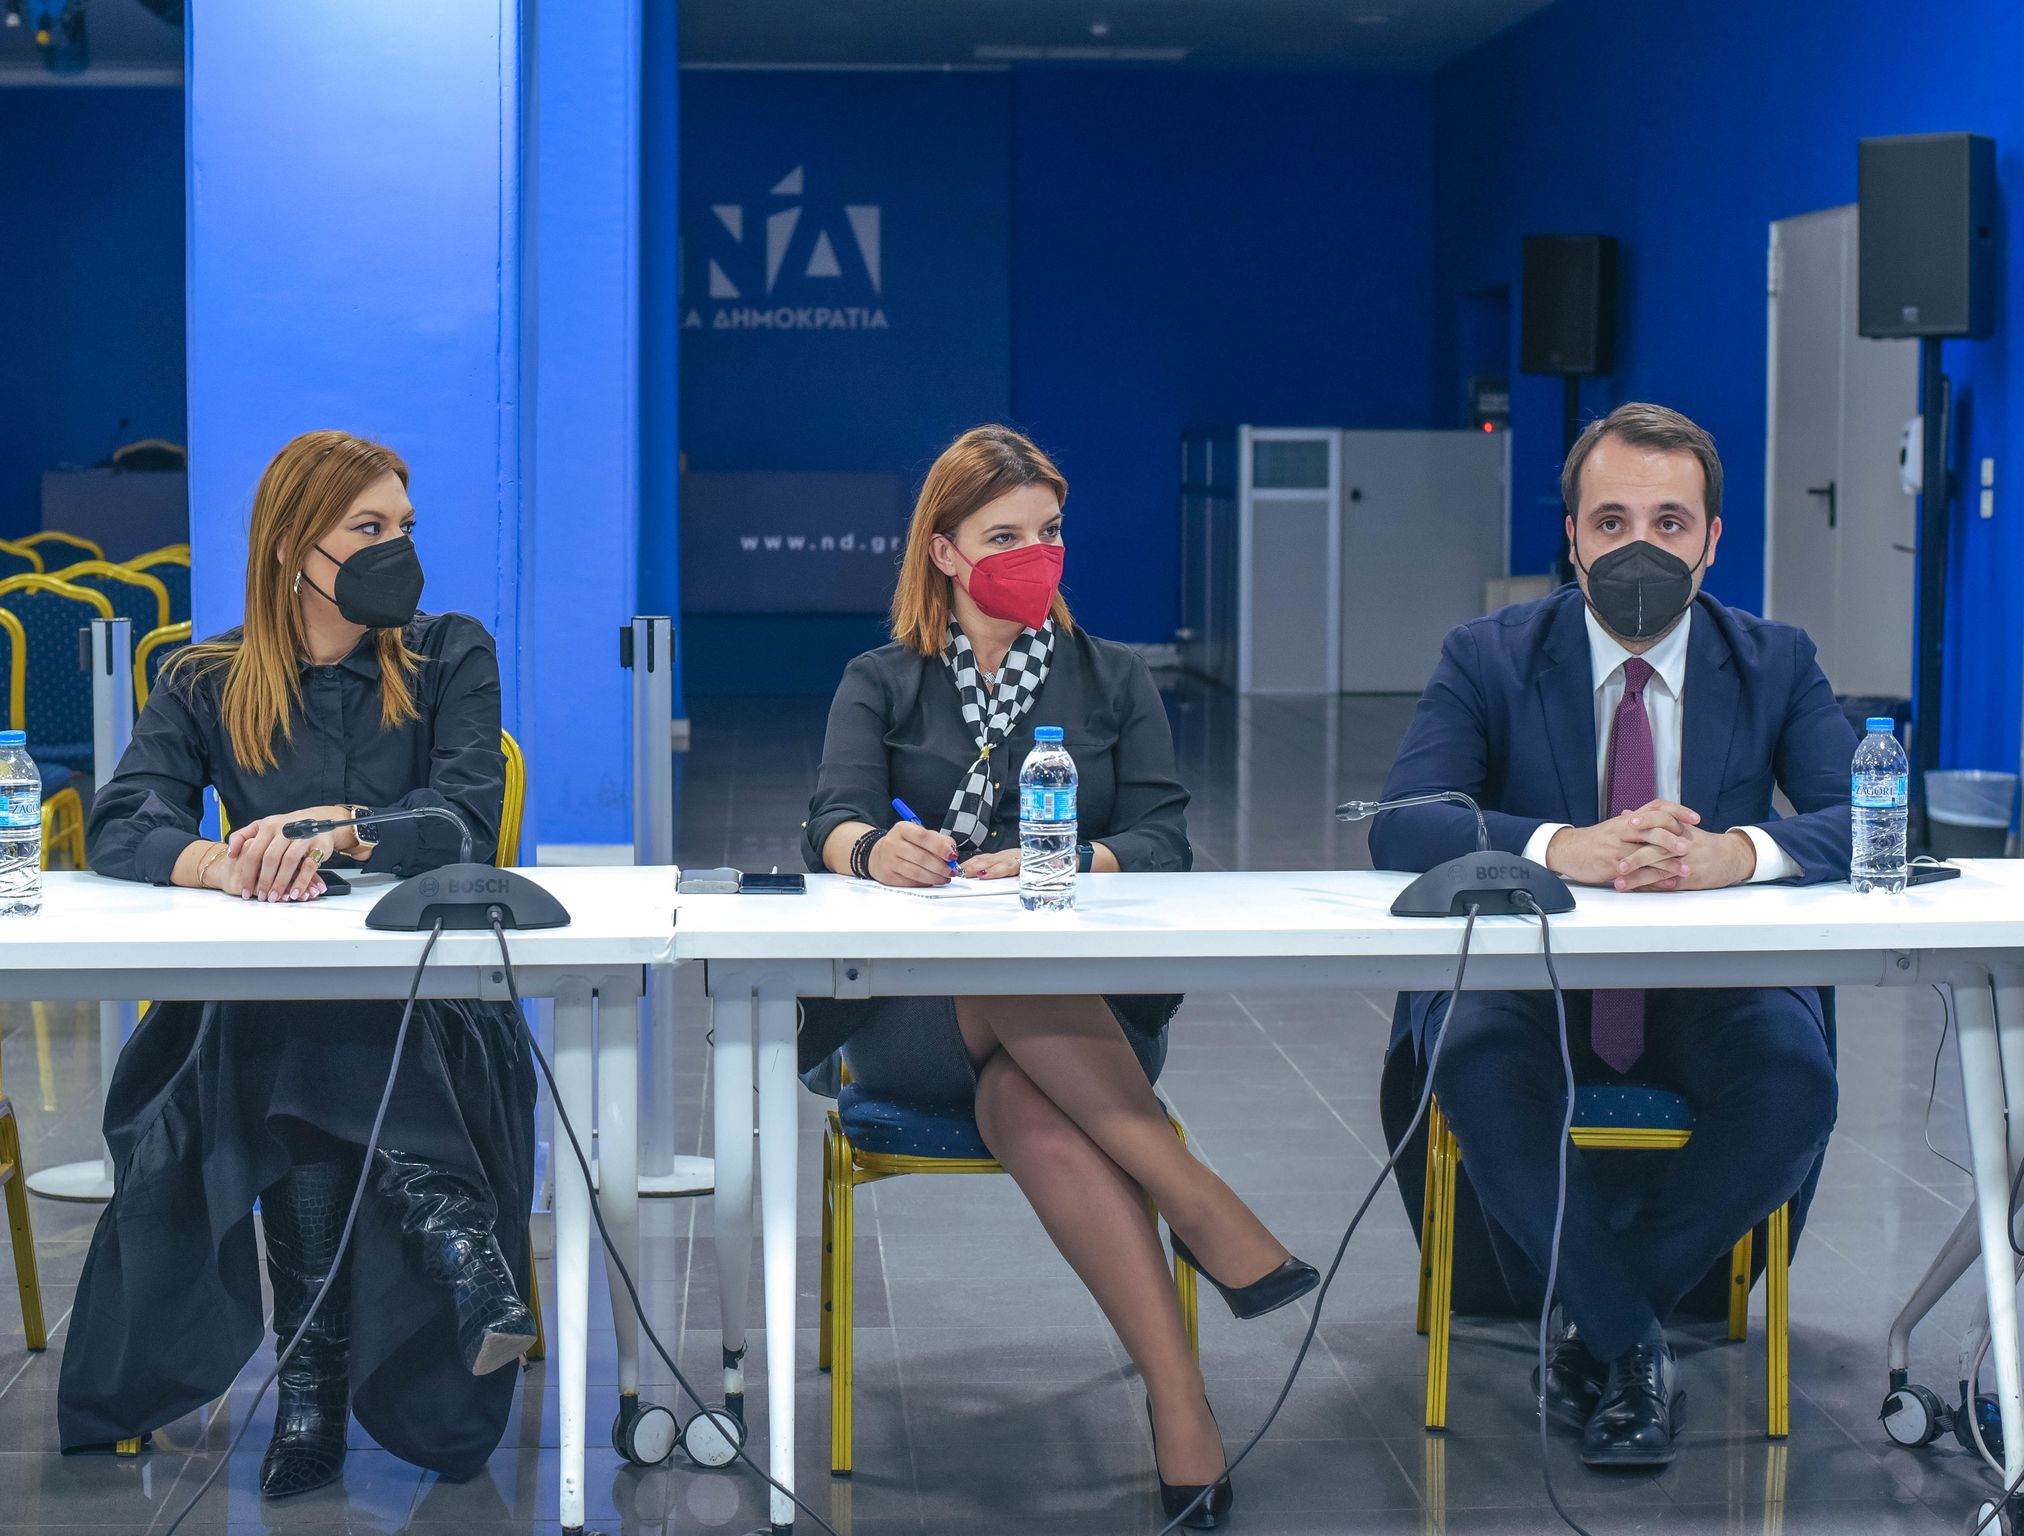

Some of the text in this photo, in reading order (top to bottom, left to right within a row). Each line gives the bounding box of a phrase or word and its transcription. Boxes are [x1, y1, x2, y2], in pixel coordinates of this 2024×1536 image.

[712, 306, 890, 330] ΔΗΜΟΚΡΑΤΙΑ
[739, 532, 900, 554] www.nd.gr
[1855, 784, 1894, 796] ZAGORI
[1475, 865, 1531, 880] BOSCH
[448, 878, 511, 894] BOSCH
